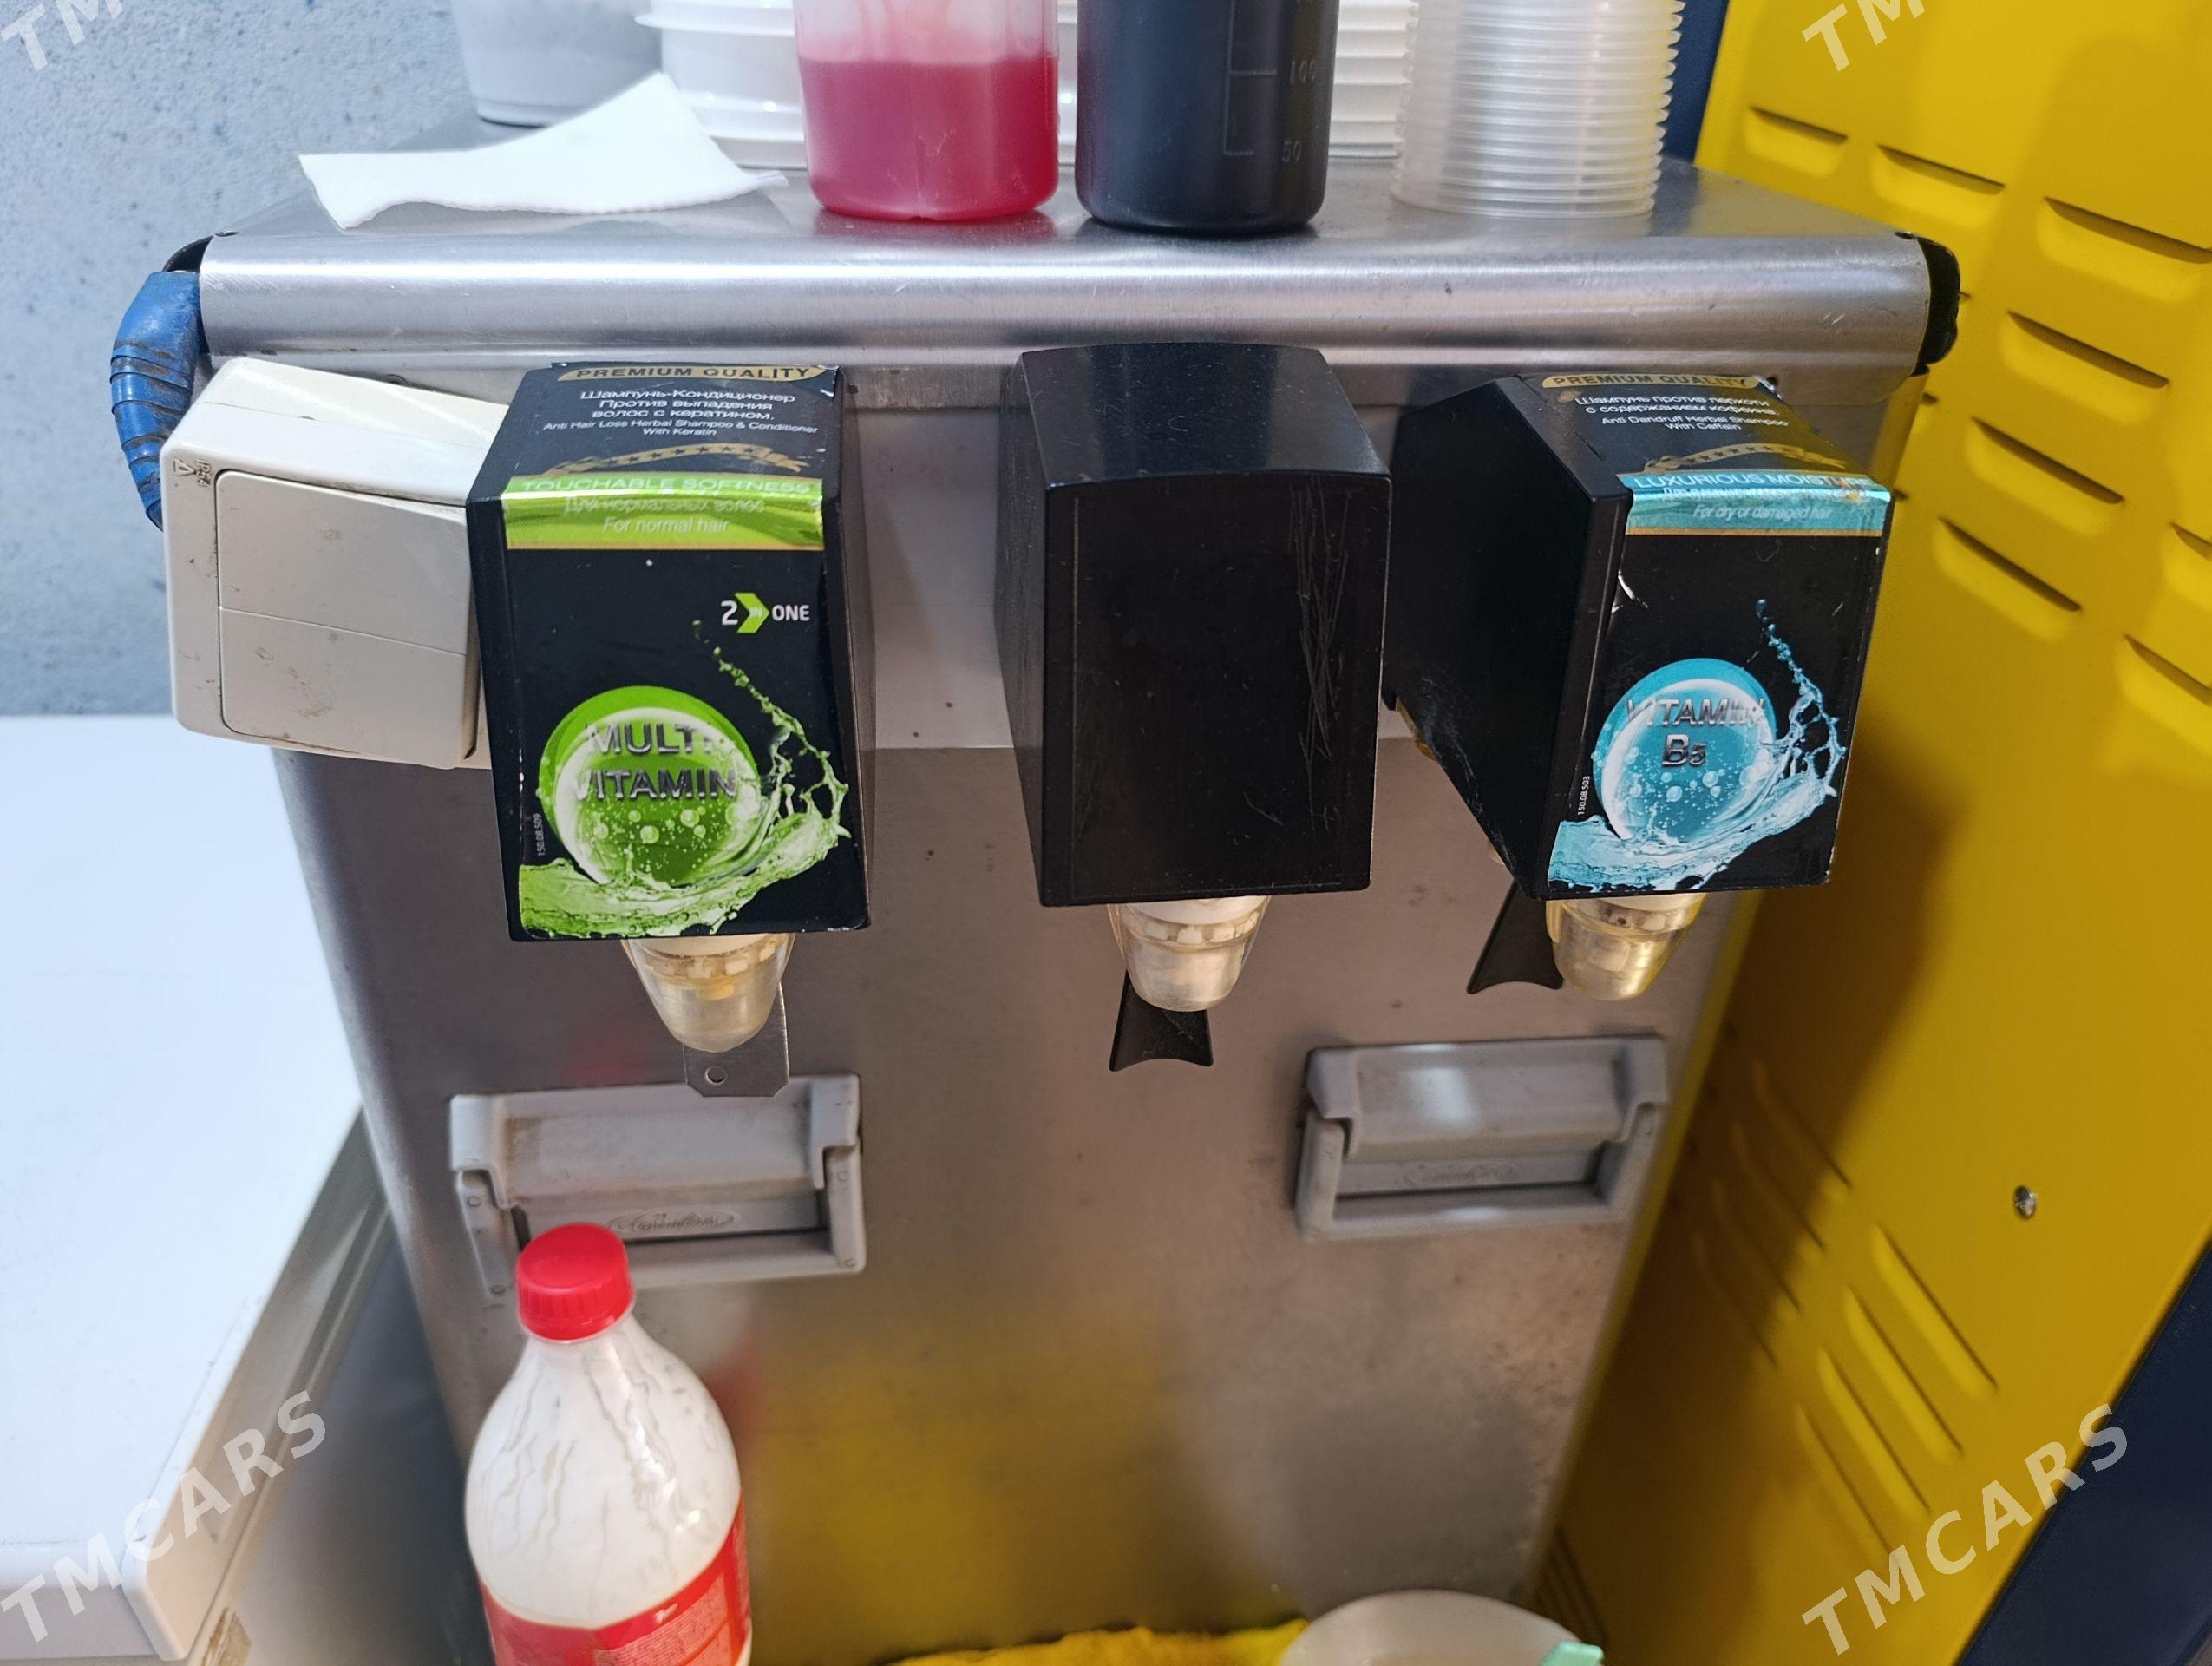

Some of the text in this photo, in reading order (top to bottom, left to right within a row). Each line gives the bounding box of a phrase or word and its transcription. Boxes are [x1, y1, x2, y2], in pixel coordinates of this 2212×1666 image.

[1281, 140, 1301, 163] 50
[576, 367, 810, 379] PREMIUM QUALITY
[1553, 376, 1652, 385] PREMIUM
[579, 390, 795, 403] Шампунь-Кондиционер
[1575, 396, 1650, 404] Шампунь
[599, 399, 773, 410] Против выпадения
[1599, 404, 1706, 413] содержанием
[592, 410, 650, 418] волос
[675, 419, 733, 429] Shampoo
[748, 422, 819, 433] Conditioner
[1602, 416, 1626, 425] Anti
[1730, 416, 1789, 426] Shampoo
[521, 478, 810, 495] TOUCHABLE SOFTNESS
[1634, 474, 1764, 488] LUXURIOUS
[1693, 503, 1714, 518] For
[603, 516, 730, 534] For normal hair
[721, 600, 738, 625] 2
[772, 605, 810, 621] ONE
[1662, 733, 1708, 767] B5
